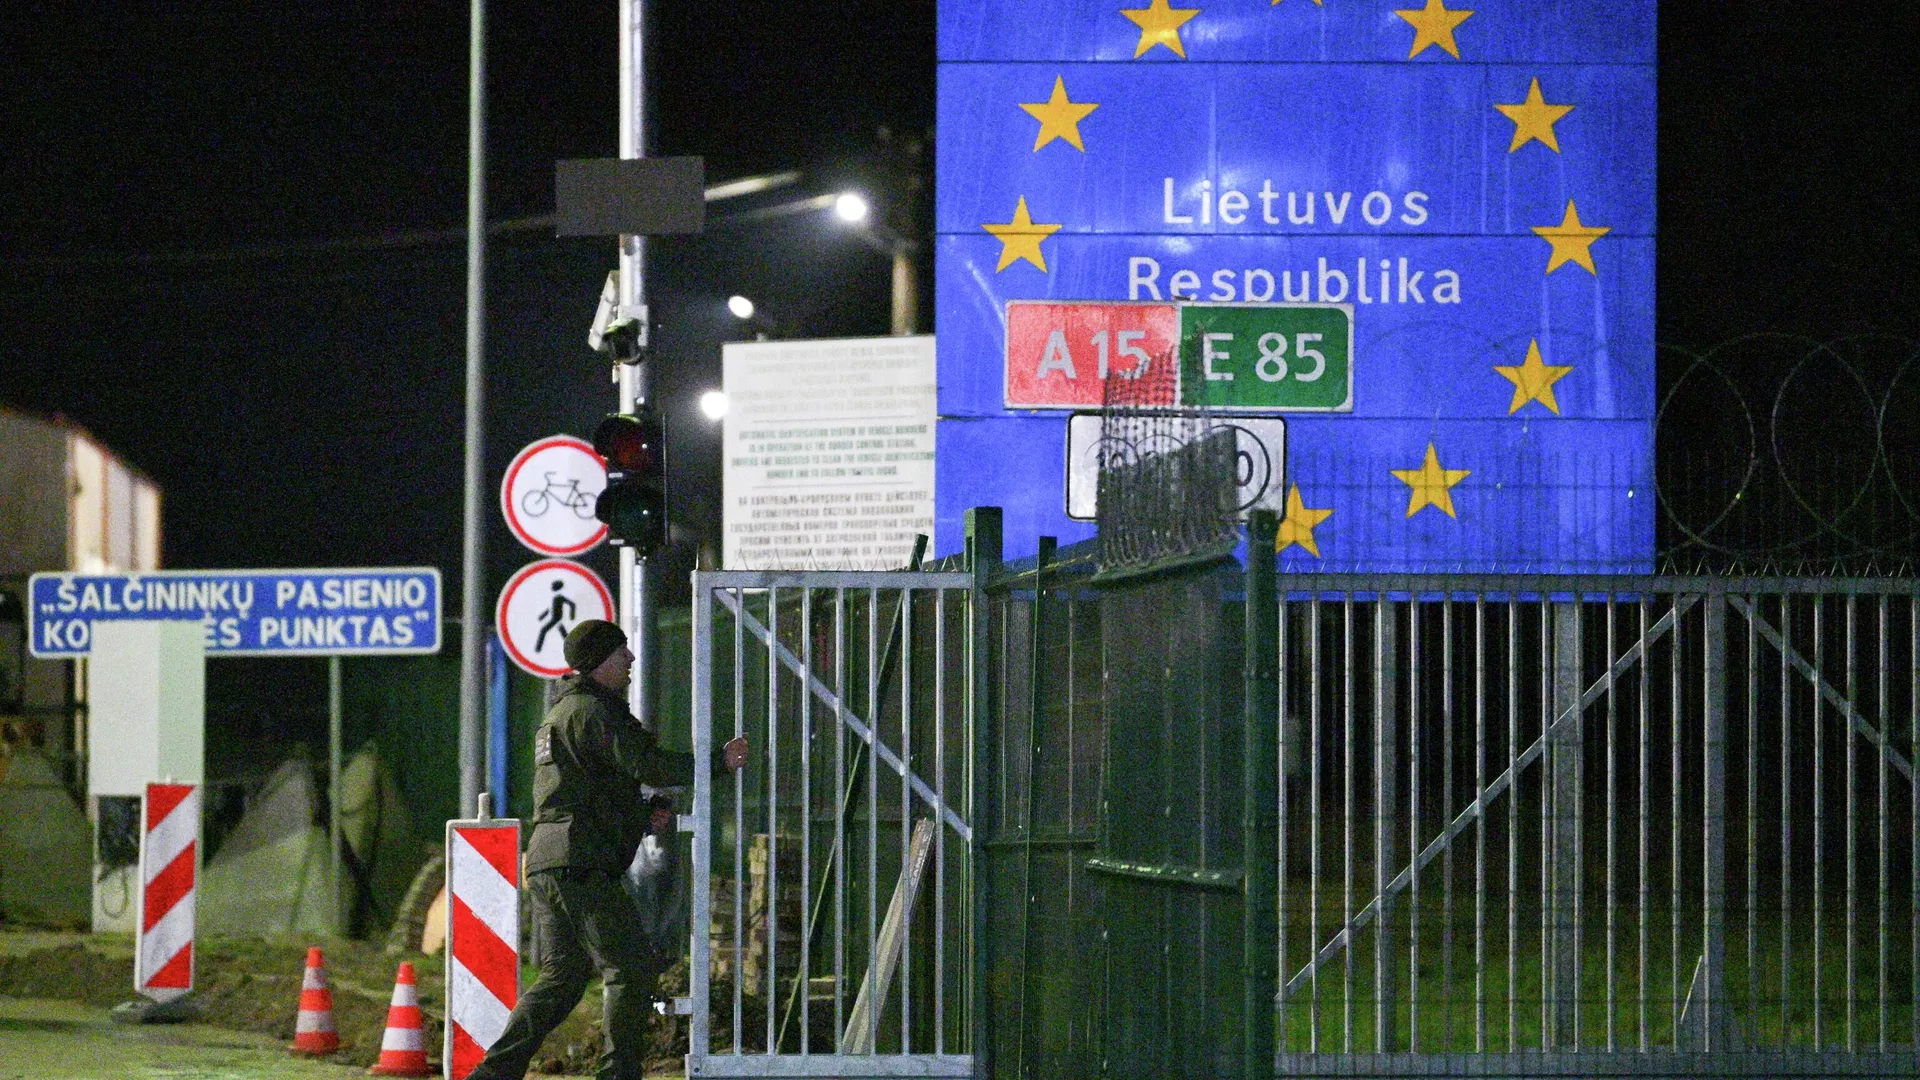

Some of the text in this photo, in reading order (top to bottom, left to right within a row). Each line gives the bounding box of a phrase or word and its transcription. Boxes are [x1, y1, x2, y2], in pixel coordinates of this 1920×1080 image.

[1163, 176, 1430, 226] Lietuvos
[1127, 256, 1462, 305] Respublika
[1036, 329, 1150, 381] A 15
[1203, 331, 1327, 383] E 85
[275, 577, 427, 610] PASIENIO
